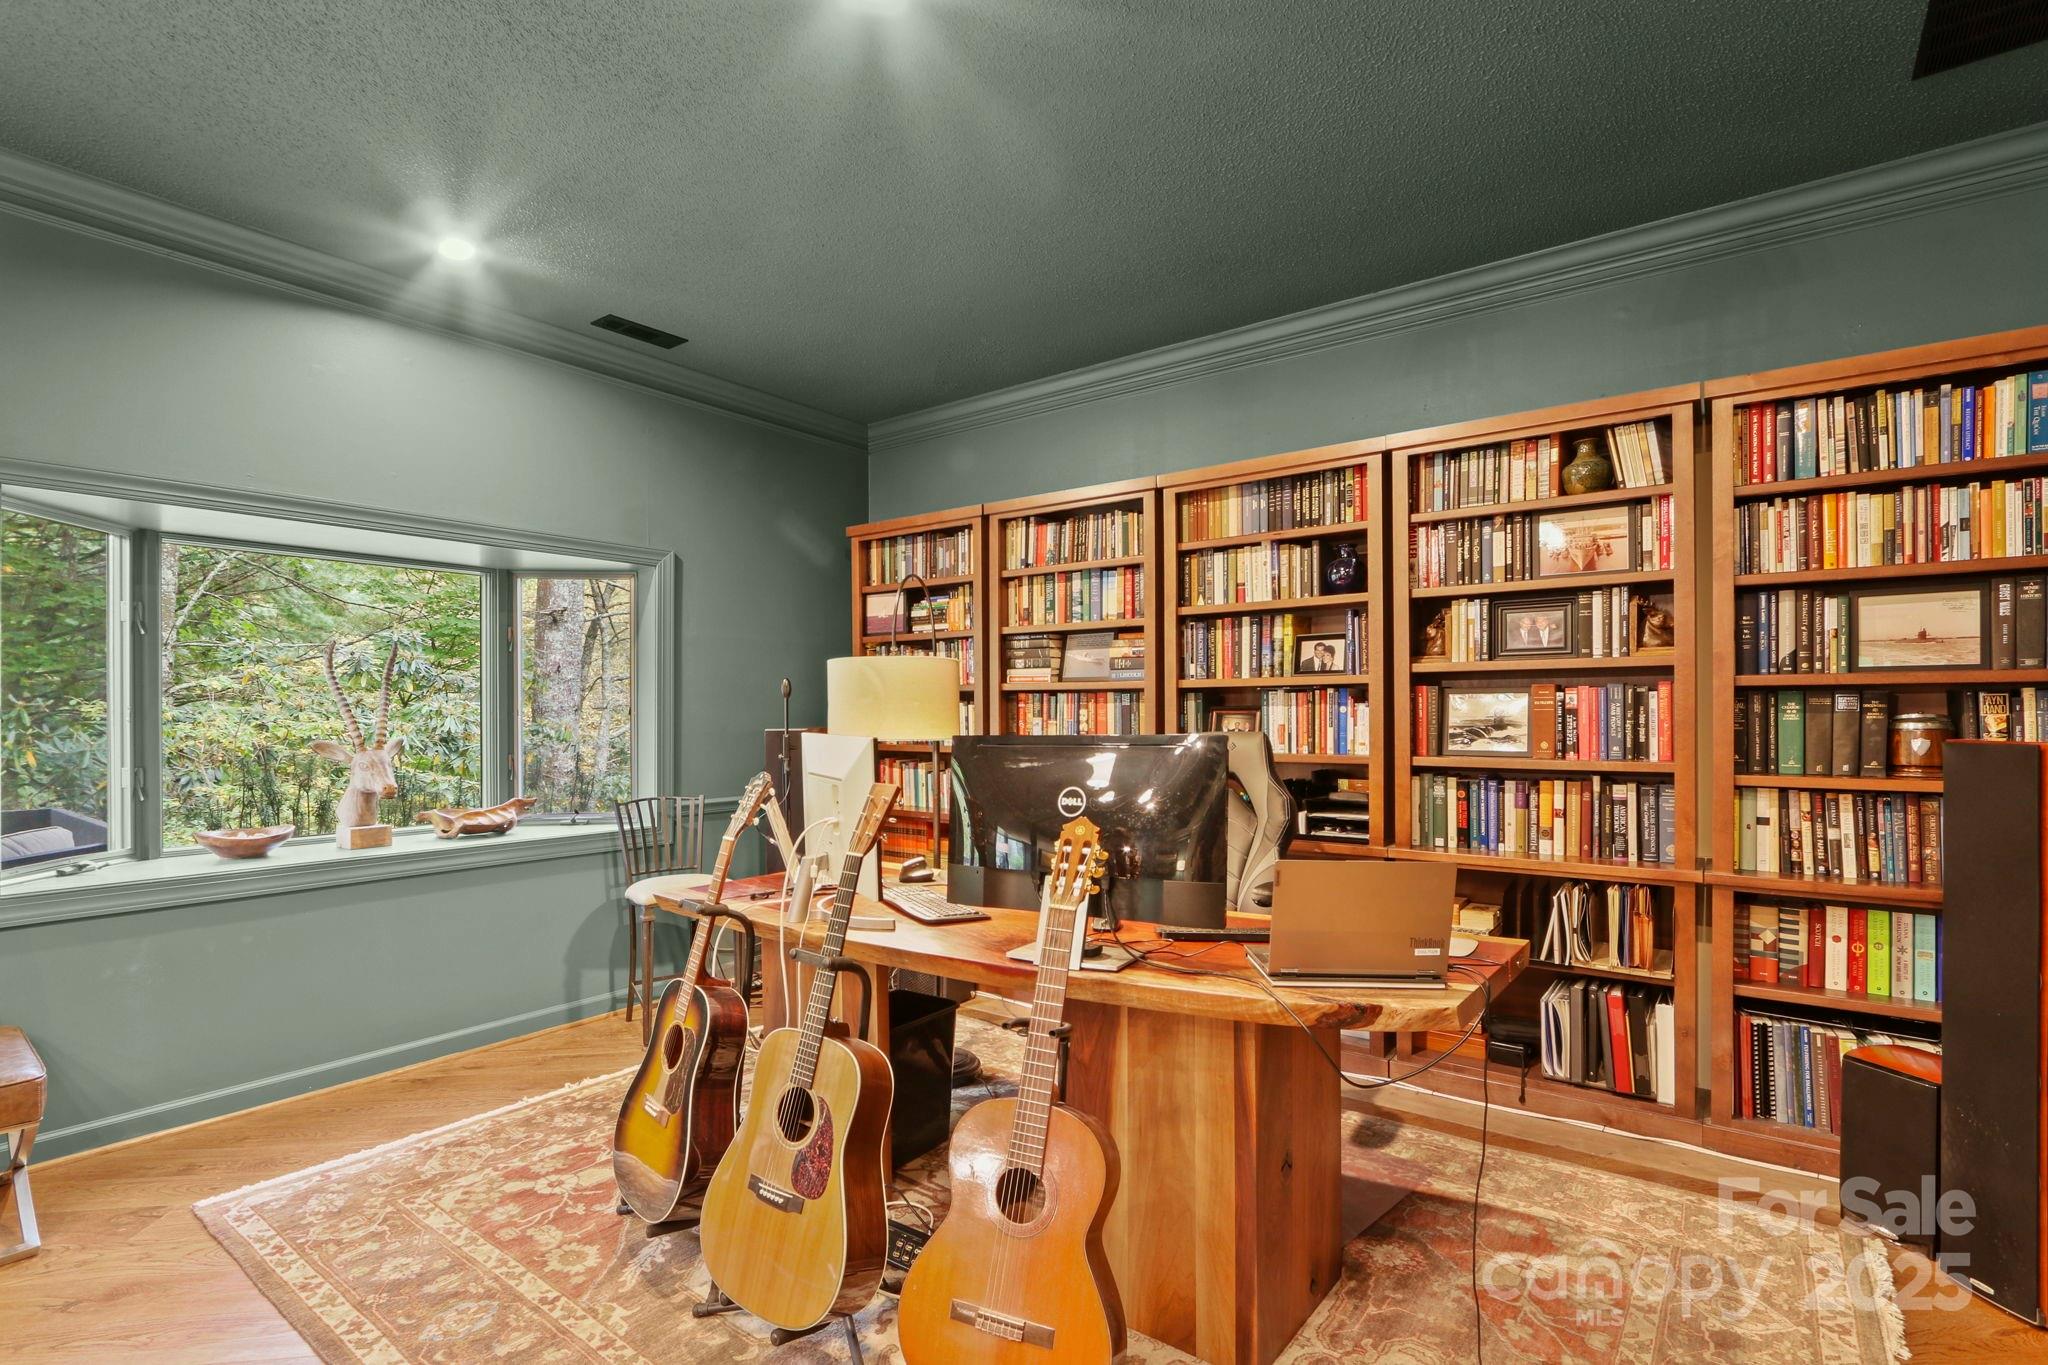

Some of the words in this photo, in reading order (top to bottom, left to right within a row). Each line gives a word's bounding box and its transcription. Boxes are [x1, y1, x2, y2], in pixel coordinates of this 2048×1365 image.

[1409, 526, 1418, 559] MAILER
[1825, 528, 1837, 556] belief
[1999, 583, 2011, 600] GHOST
[1999, 601, 2011, 616] WARS
[1983, 704, 2006, 714] RAND
[1985, 695, 2004, 705] AYN
[1061, 797, 1083, 806] DELL
[1829, 802, 1838, 825] EHRMAN
[1894, 812, 1904, 838] PAUL
[1815, 923, 1823, 947] SCOTCH
